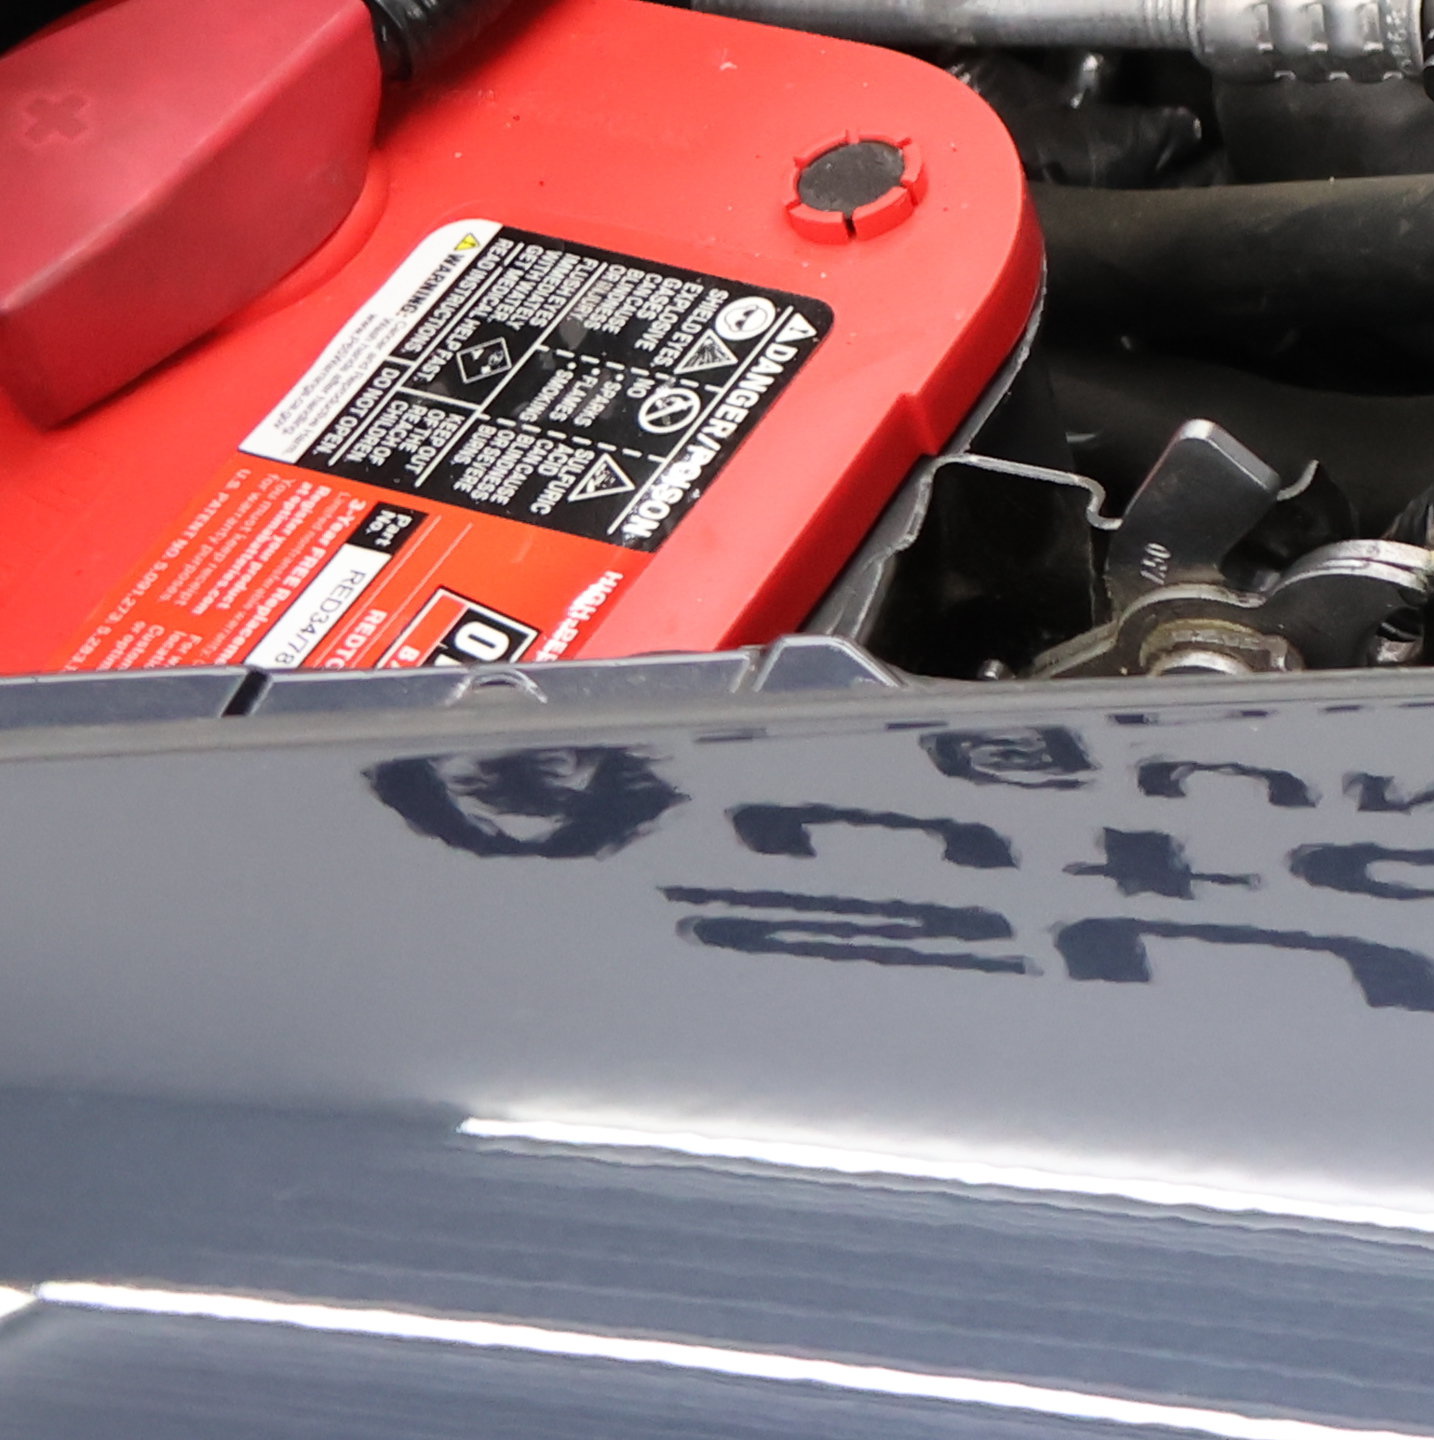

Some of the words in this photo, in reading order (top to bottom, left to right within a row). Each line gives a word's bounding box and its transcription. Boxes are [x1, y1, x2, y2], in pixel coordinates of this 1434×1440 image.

[475, 238, 514, 271] READ
[513, 244, 544, 270] GET
[524, 249, 562, 281] WITH
[600, 264, 627, 282] OR
[398, 253, 461, 315] WARNING:
[468, 268, 524, 318] MEDICAL
[505, 253, 580, 330] IMMEDIATELY
[554, 257, 598, 296] FLUSH
[631, 273, 663, 297] CAN
[400, 269, 487, 354] INSTRUCTIONS.
[486, 280, 536, 323] WATER.
[528, 295, 567, 327] EYES
[582, 268, 645, 329] BLINDNESS
[601, 296, 643, 334] CAUSE
[634, 282, 704, 351] EXPLOSIVE
[635, 277, 683, 320] GASES
[680, 288, 729, 333] SHIELD
[443, 318, 480, 351] HELP
[649, 332, 693, 369] EYES.
[357, 351, 378, 370] and
[372, 367, 401, 388] DO
[412, 349, 453, 382] FAST.
[349, 387, 384, 417] NOT
[518, 369, 573, 421] SMOKING
[548, 375, 598, 421] FLAMES
[573, 381, 621, 426] SPARKS
[625, 377, 655, 398] NO
[312, 415, 359, 455] OPEN.
[380, 404, 428, 447] REACH
[420, 409, 446, 430] OF
[427, 413, 465, 447] KEEP
[367, 446, 392, 465] OF
[398, 429, 430, 453] THE
[449, 424, 496, 465] BURNS.
[489, 429, 516, 449] OR
[521, 439, 554, 465] CAN
[621, 342, 798, 538] DANGER/POISON
[404, 446, 437, 474] OUT
[452, 447, 500, 492] SEVERE
[469, 433, 535, 500] BLINDNESS
[536, 443, 574, 476] ACID
[256, 473, 279, 491] for
[267, 478, 295, 499] You
[295, 481, 312, 495] at
[489, 463, 534, 504] CAUSE
[529, 448, 595, 515] SULFURIC
[182, 492, 229, 538] PATENT
[208, 492, 261, 544] warranty
[239, 501, 273, 532] must
[280, 485, 332, 535] Register
[316, 498, 367, 546] 3-Year
[364, 510, 396, 535] No.
[212, 533, 246, 562] keep
[257, 535, 286, 561] your
[374, 513, 412, 546] Part
[191, 495, 301, 615] optimabatteries.com
[282, 546, 326, 587] FREE
[173, 562, 219, 606] receipt
[216, 561, 264, 609] product
[273, 569, 366, 665] RED34/78
